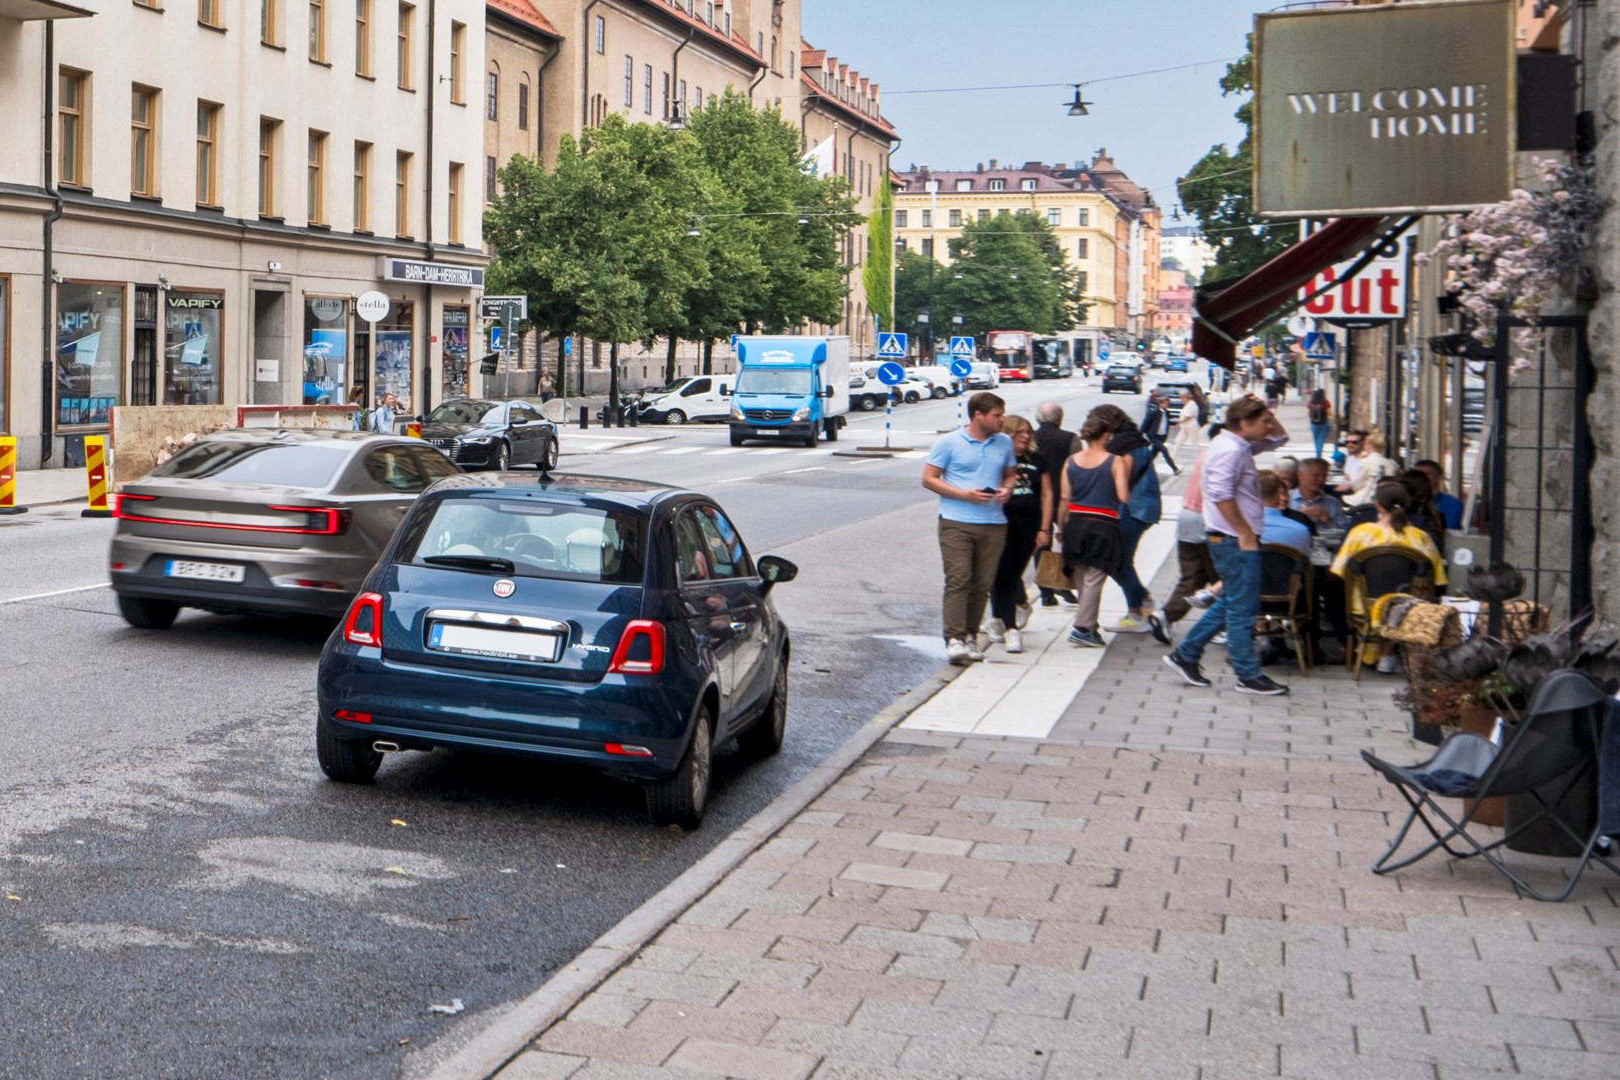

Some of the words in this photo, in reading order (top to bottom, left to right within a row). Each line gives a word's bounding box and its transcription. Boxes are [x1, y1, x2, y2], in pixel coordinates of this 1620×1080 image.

[1287, 83, 1488, 114] WELCOME
[1368, 112, 1488, 139] HOME
[1304, 266, 1400, 315] Cut
[168, 298, 222, 309] VAPIFY
[360, 300, 386, 309] stella
[315, 376, 334, 391] stella
